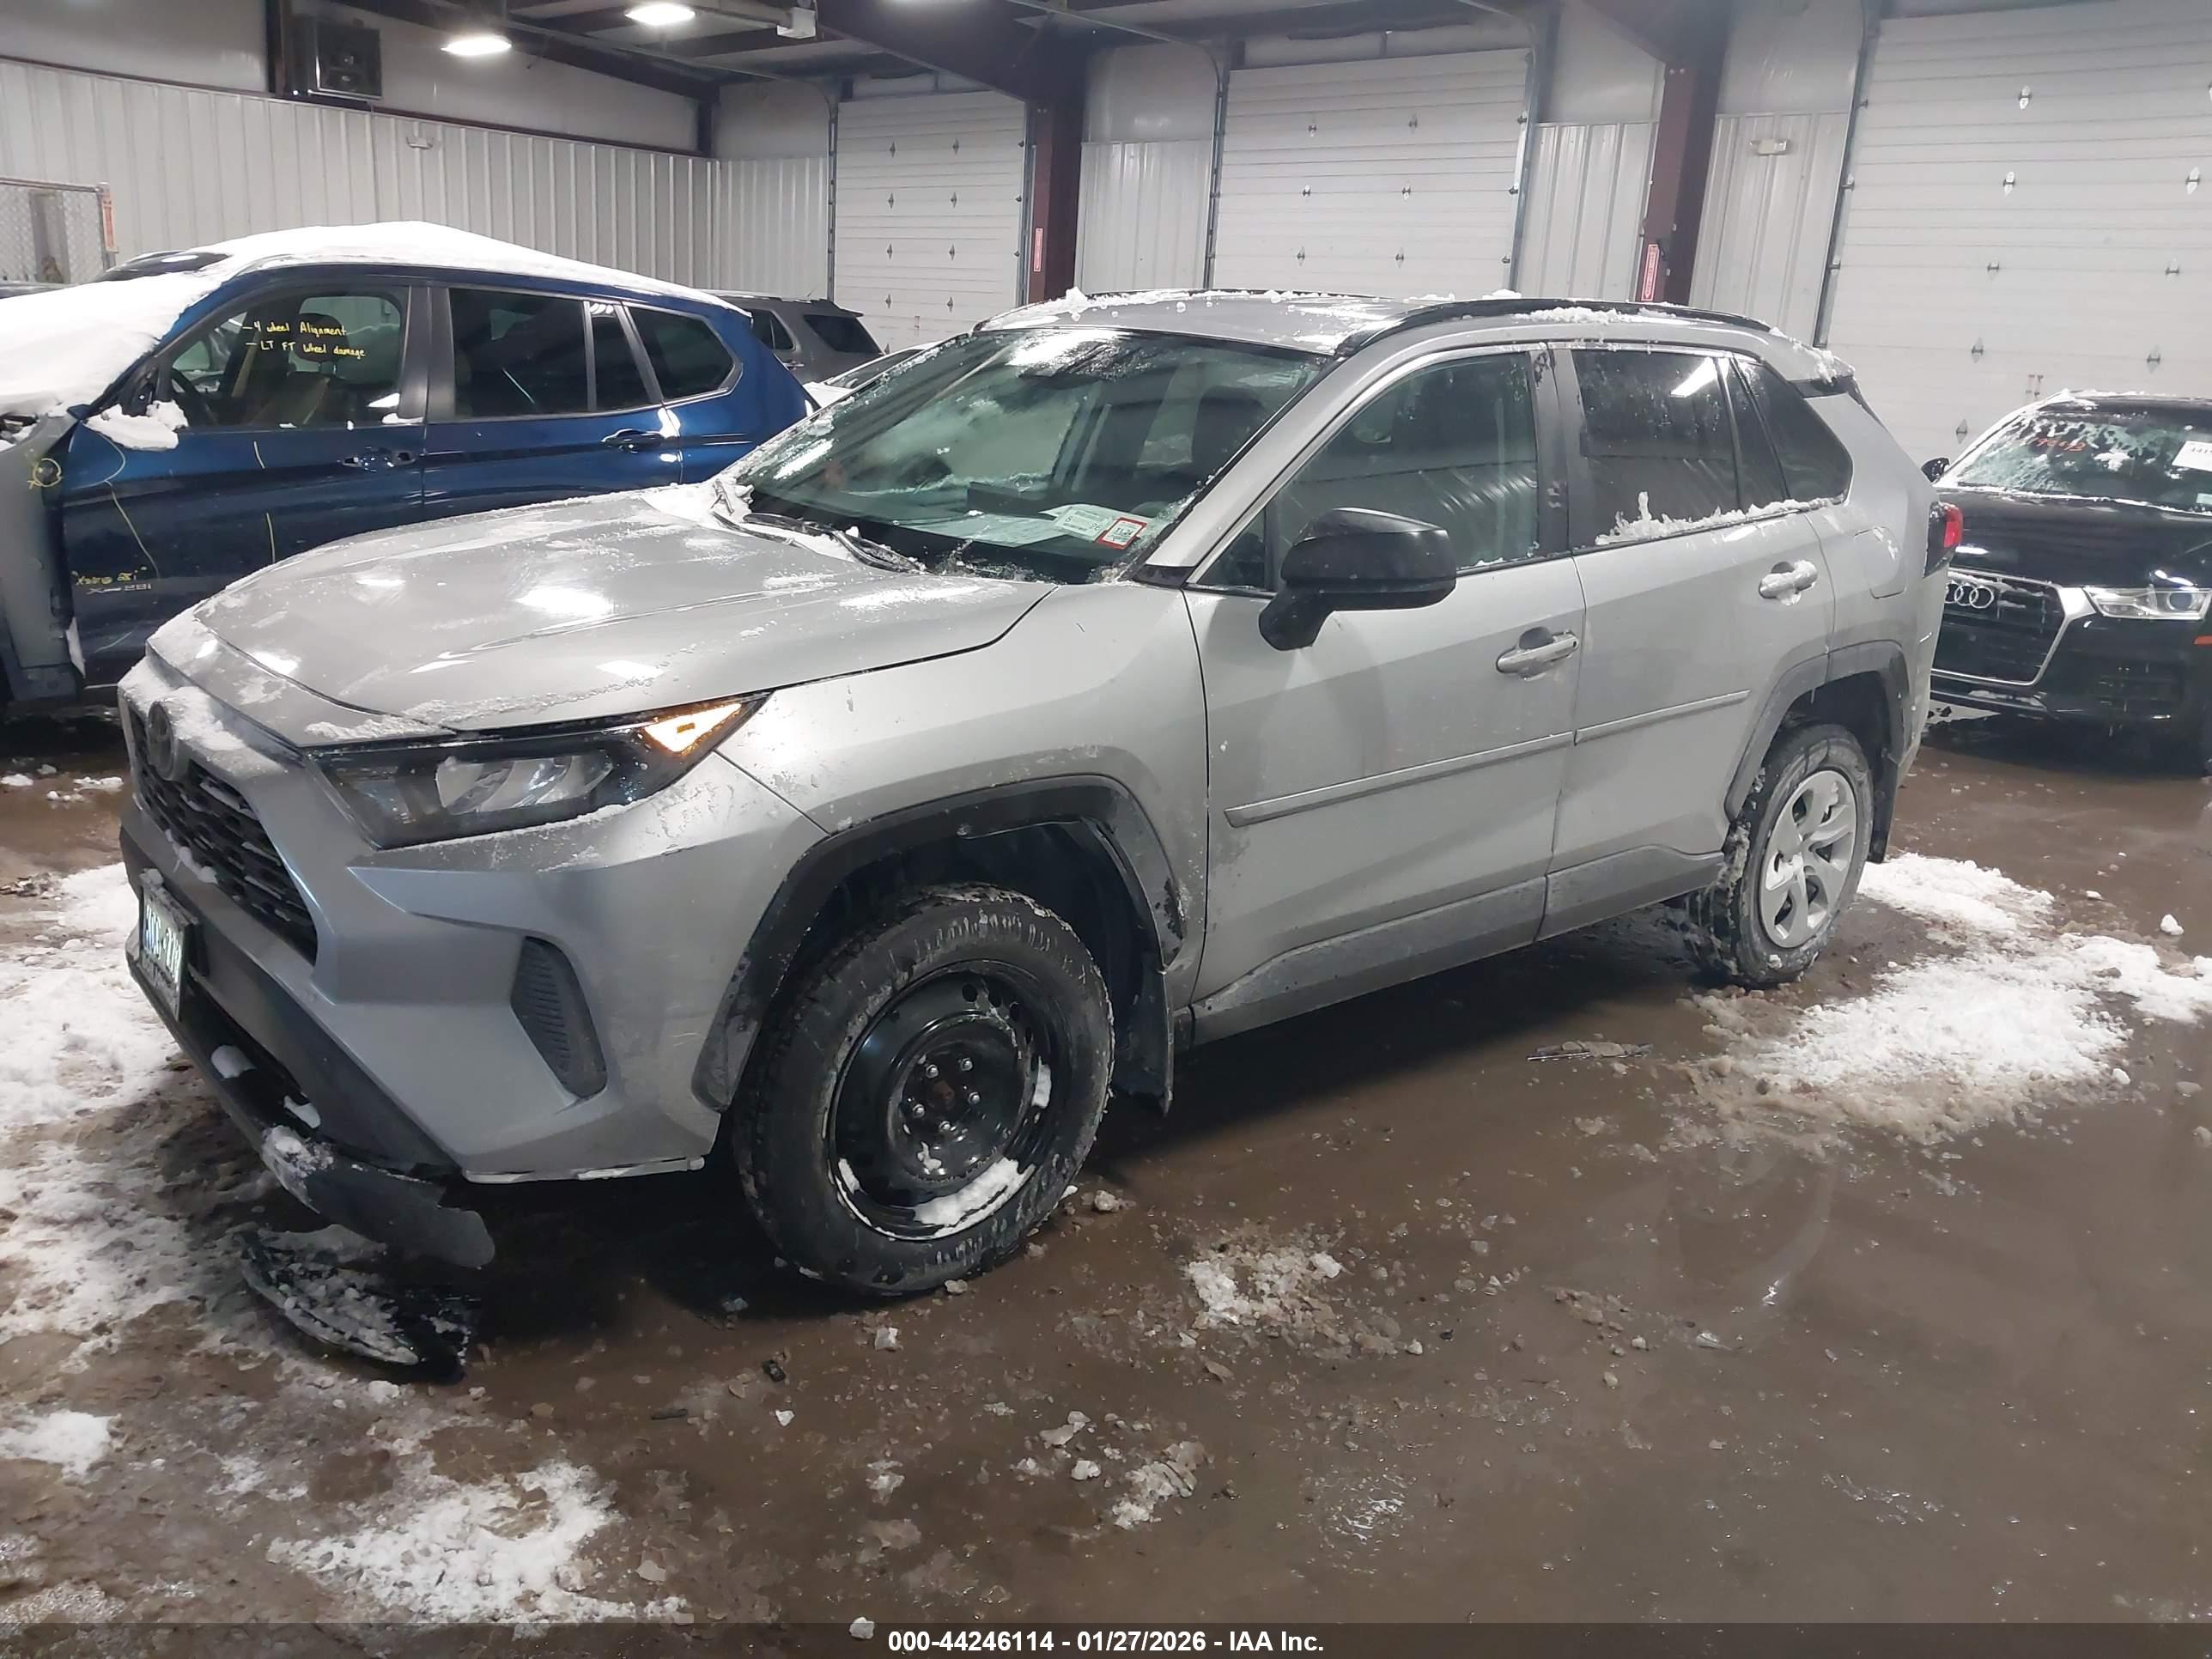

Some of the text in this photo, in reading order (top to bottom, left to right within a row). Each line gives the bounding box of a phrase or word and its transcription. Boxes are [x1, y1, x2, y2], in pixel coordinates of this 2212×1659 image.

[300, 321, 348, 338] Alignment
[282, 341, 296, 351] FT
[333, 345, 367, 359] damage
